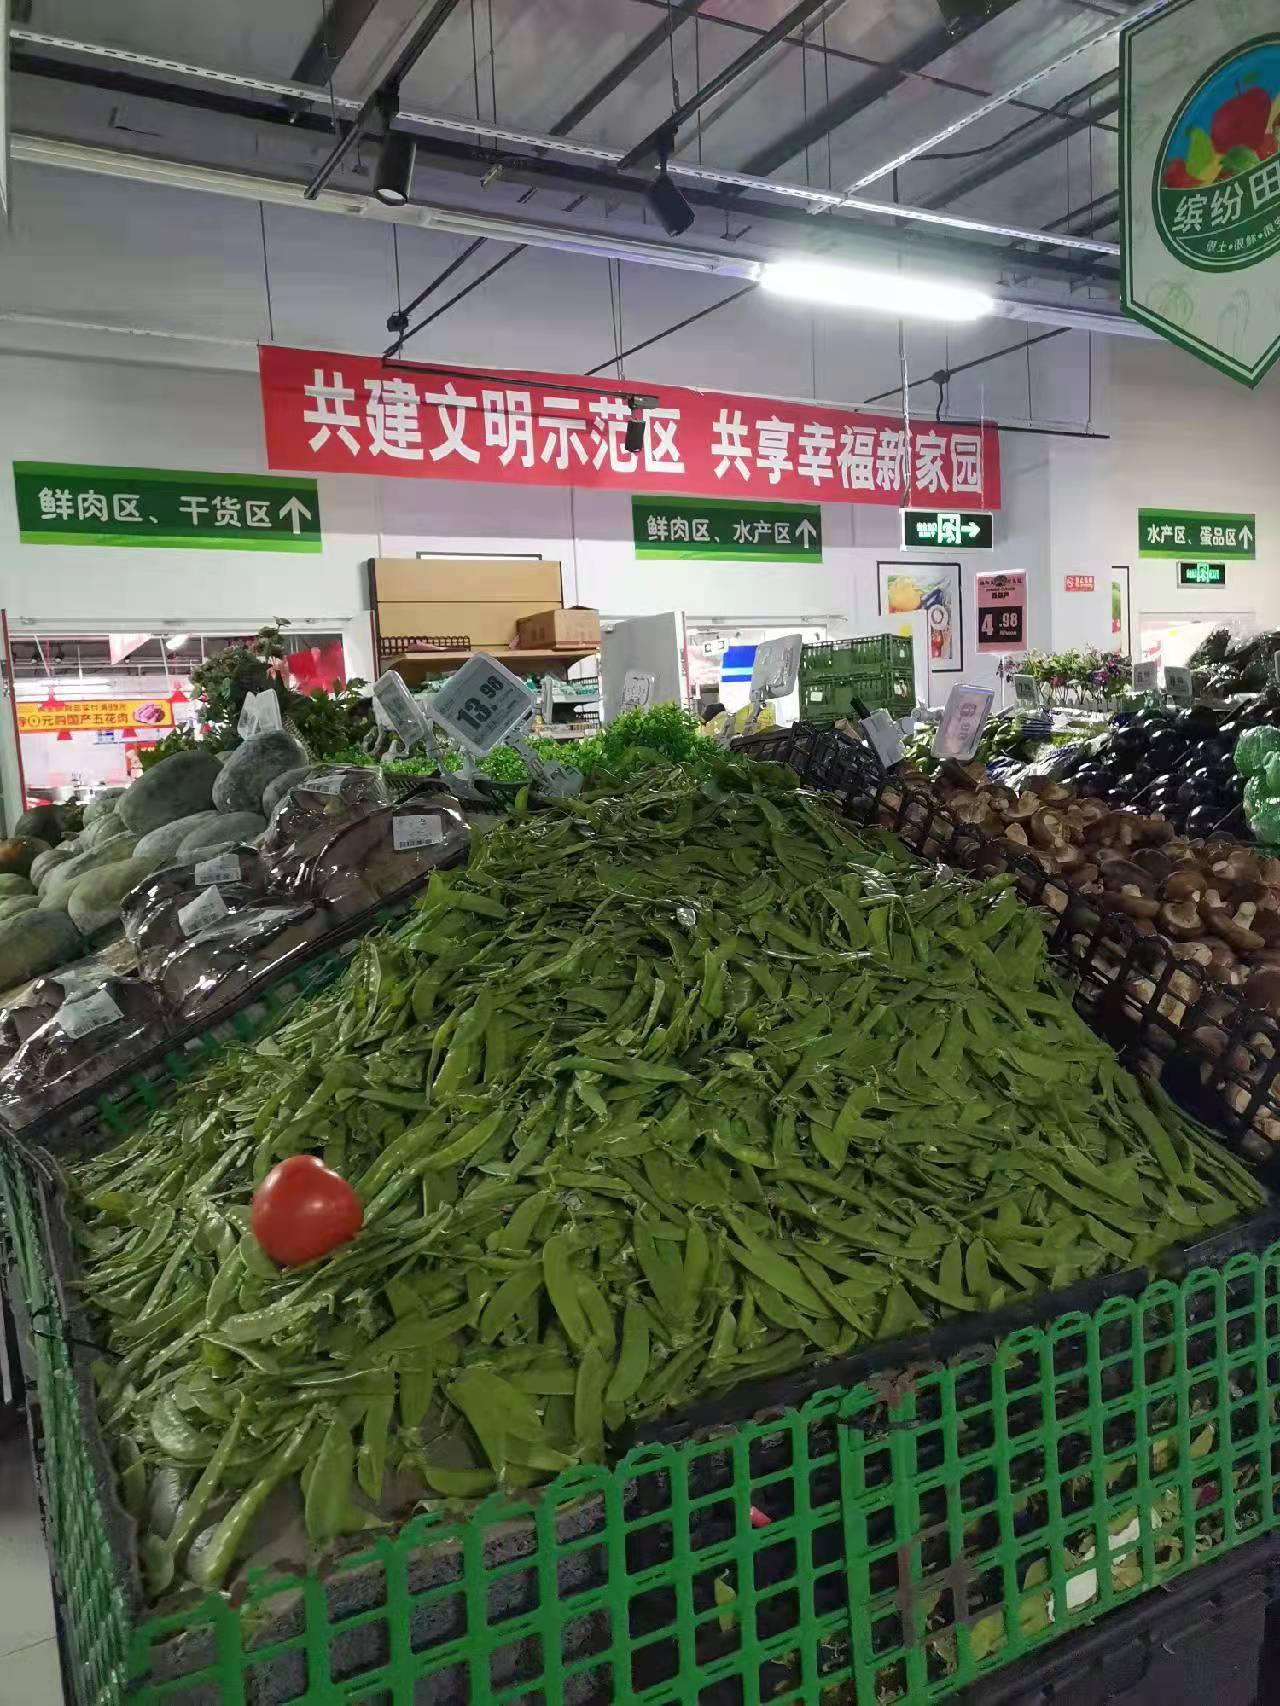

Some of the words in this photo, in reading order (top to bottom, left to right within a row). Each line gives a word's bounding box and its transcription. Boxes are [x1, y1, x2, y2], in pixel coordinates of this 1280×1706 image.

[303, 368, 686, 474] 共建文明示范区
[711, 408, 983, 494] 共享幸福新家园
